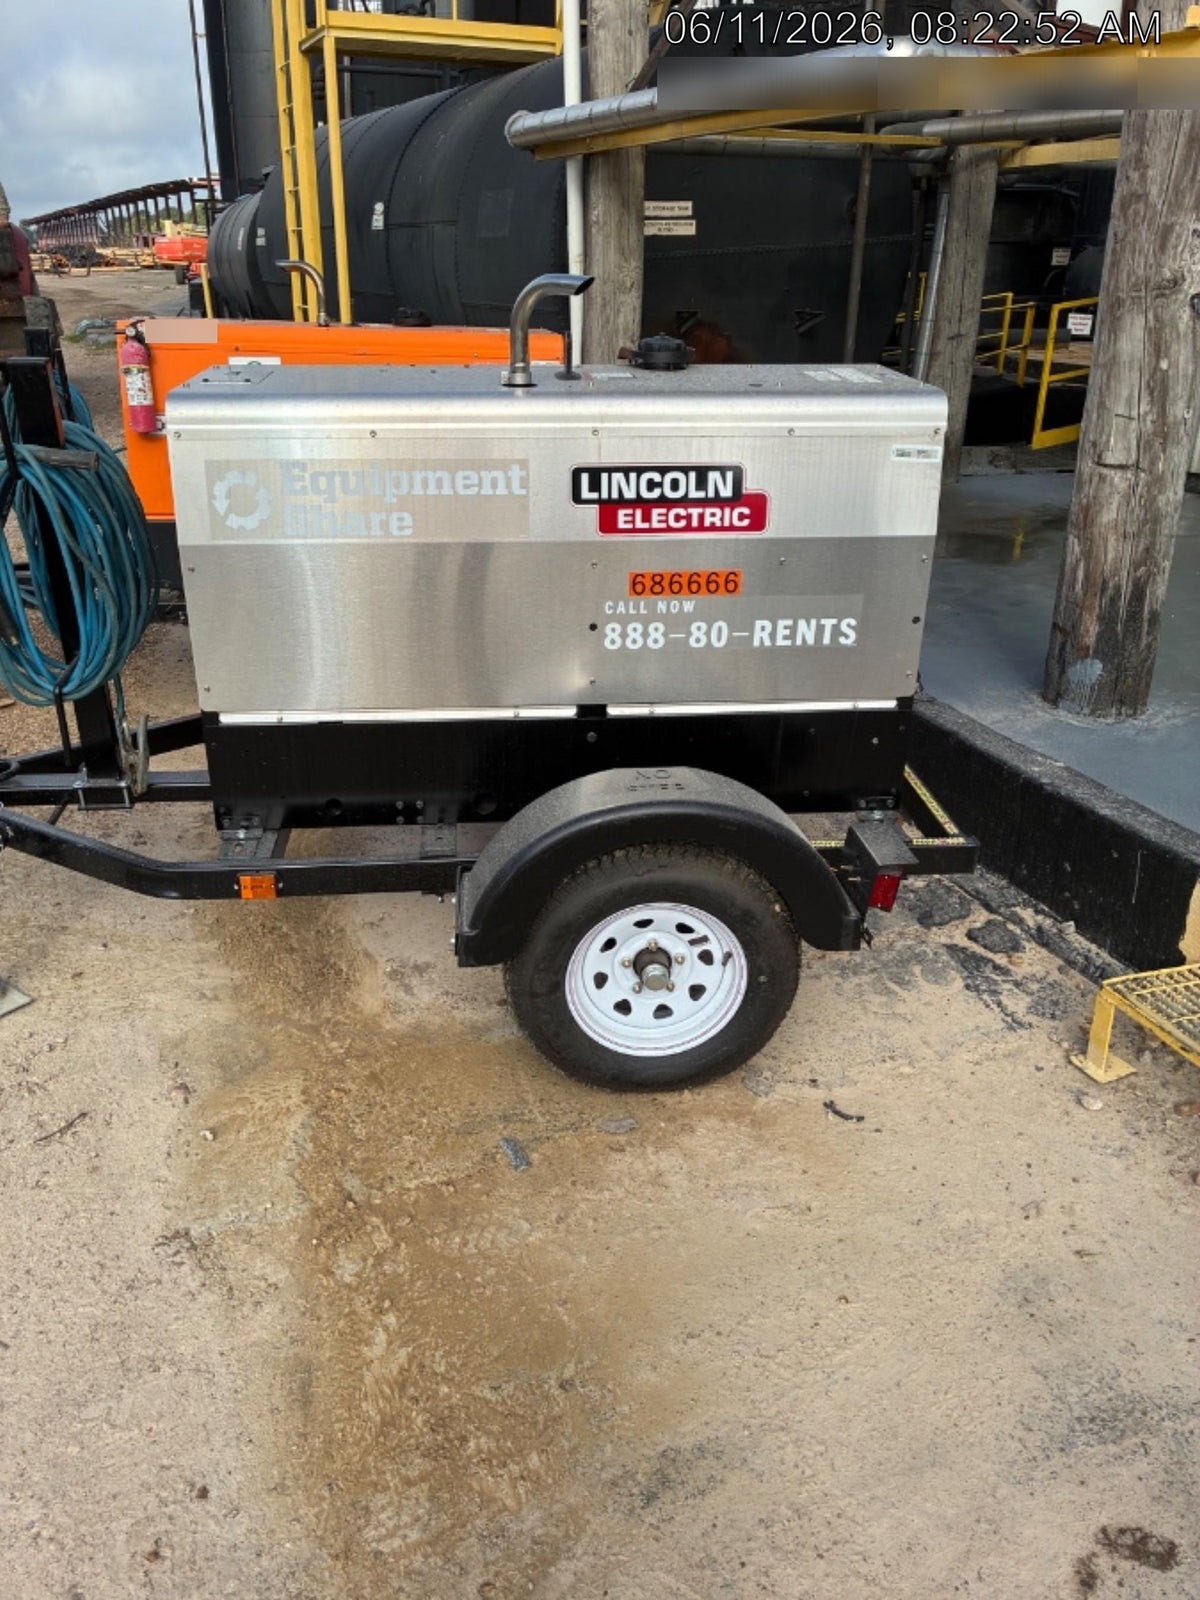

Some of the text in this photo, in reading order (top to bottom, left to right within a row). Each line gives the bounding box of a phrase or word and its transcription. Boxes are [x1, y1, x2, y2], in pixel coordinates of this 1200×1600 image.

[281, 461, 528, 504] Equipment
[580, 470, 734, 500] LINCOLN
[282, 504, 414, 537] Share
[616, 506, 751, 529] ELECTRIC
[631, 571, 739, 596] 686666
[604, 600, 696, 615] CALL NOW
[603, 617, 858, 651] 888-80-RENTS
